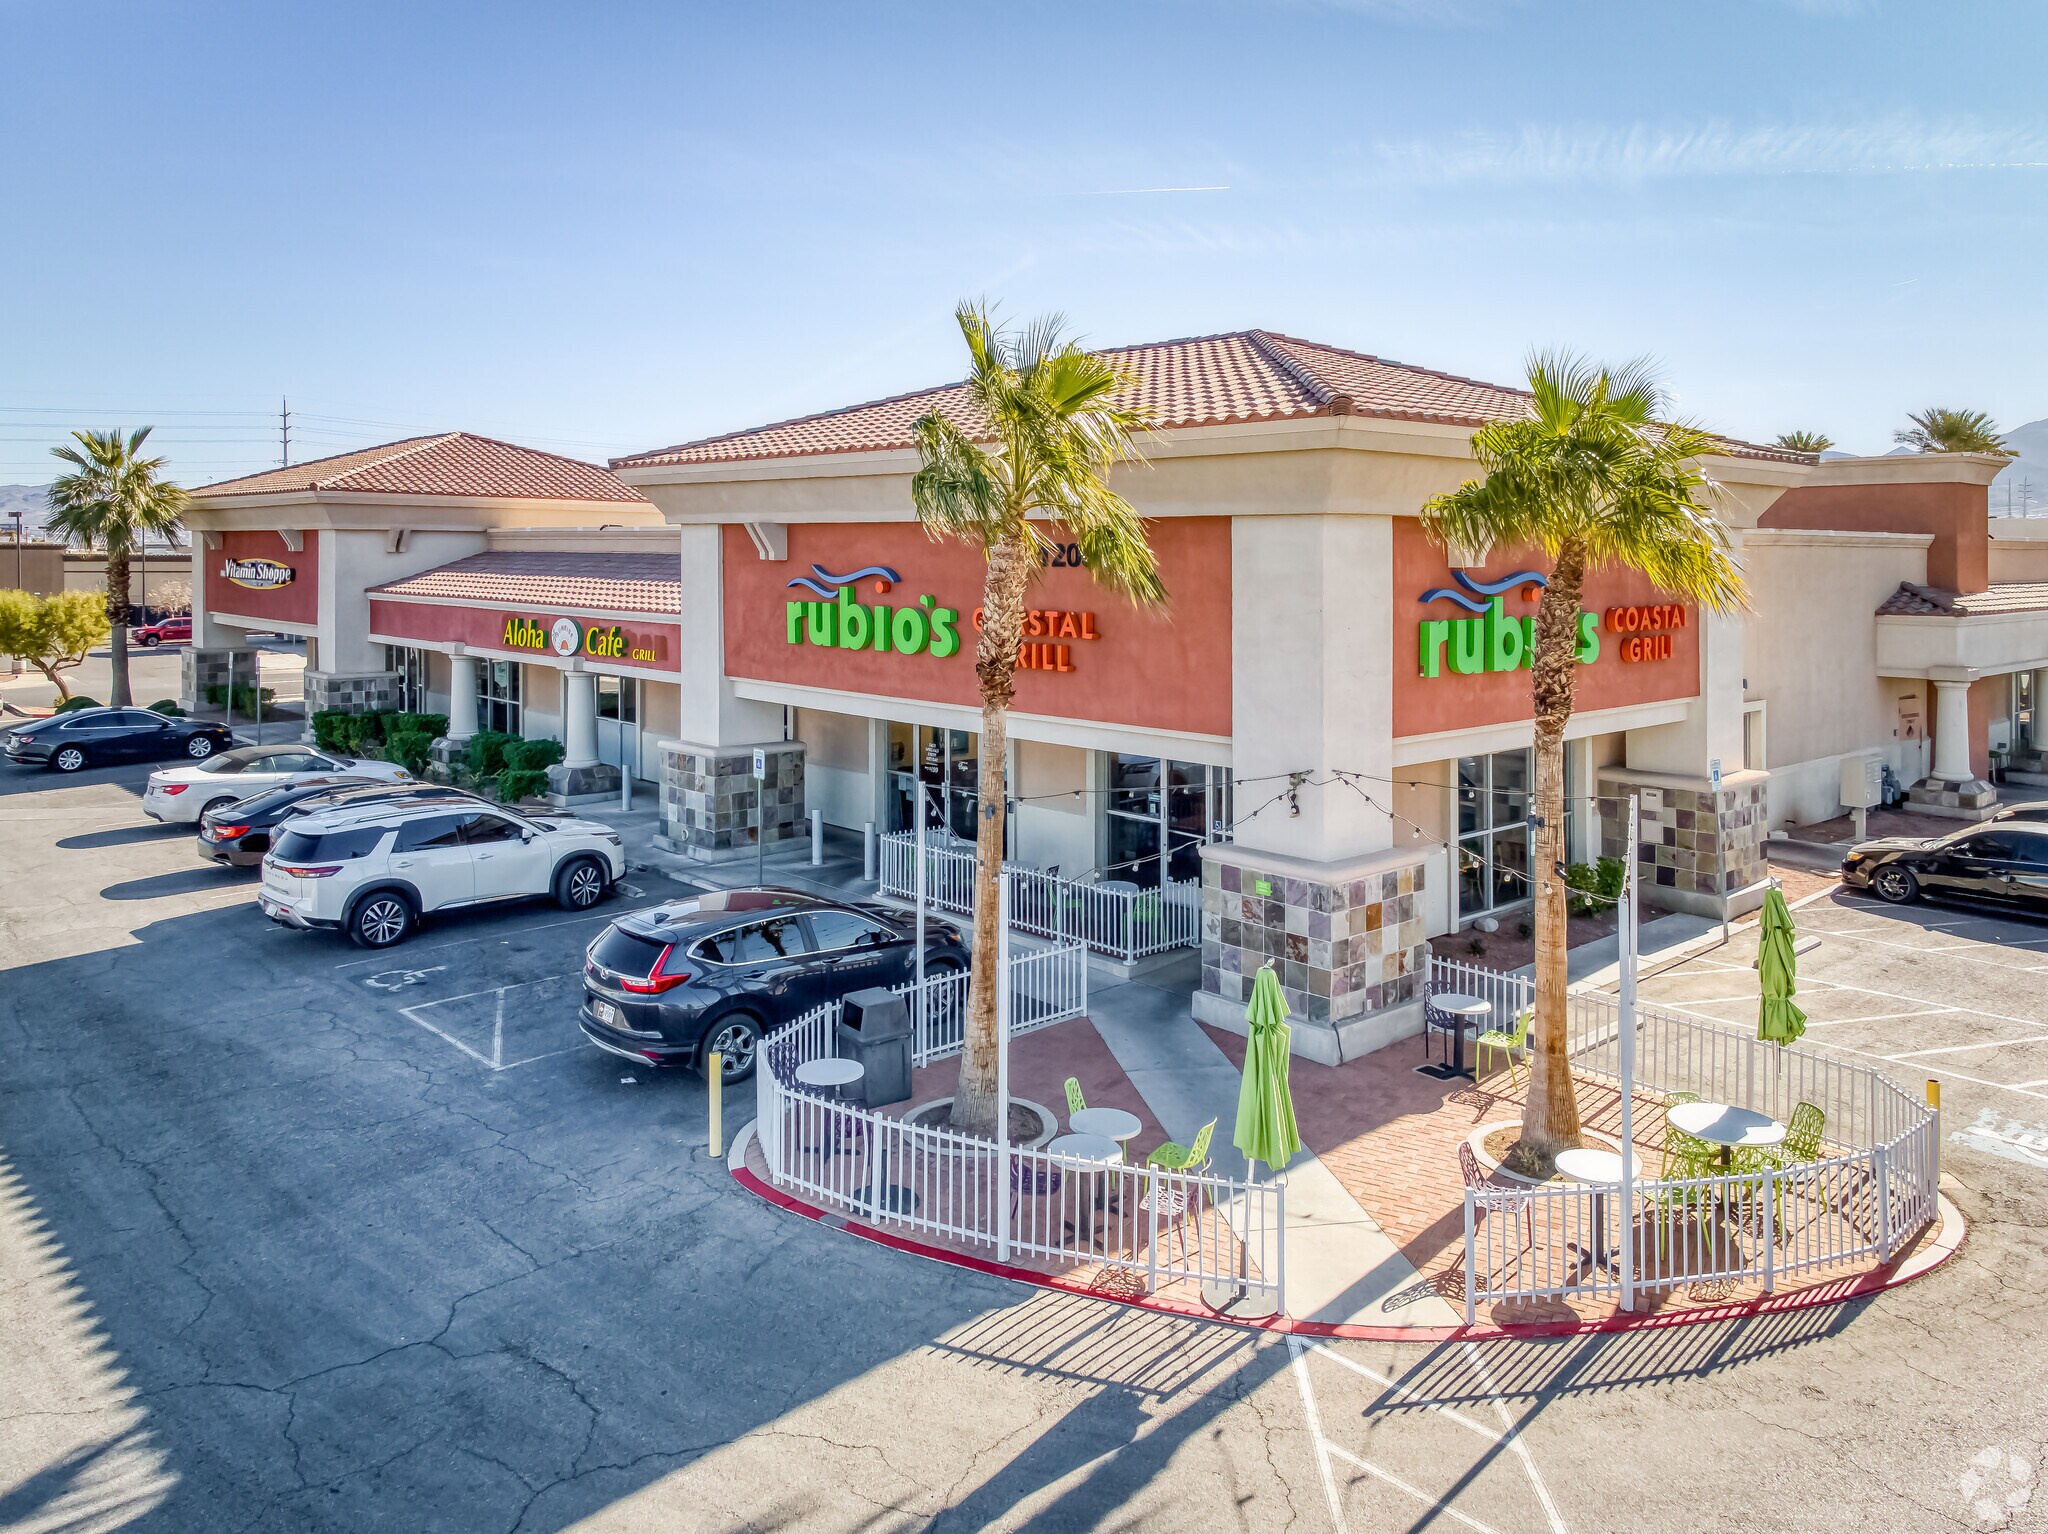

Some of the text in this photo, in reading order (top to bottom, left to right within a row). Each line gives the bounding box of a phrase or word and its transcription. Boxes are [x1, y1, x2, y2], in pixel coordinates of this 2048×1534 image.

[225, 559, 256, 579] Vitamin
[256, 563, 291, 584] Shoppe
[787, 581, 959, 658] rubio's
[503, 618, 657, 662] Aloha Cafe GRILL
[1014, 643, 1074, 672] RILL
